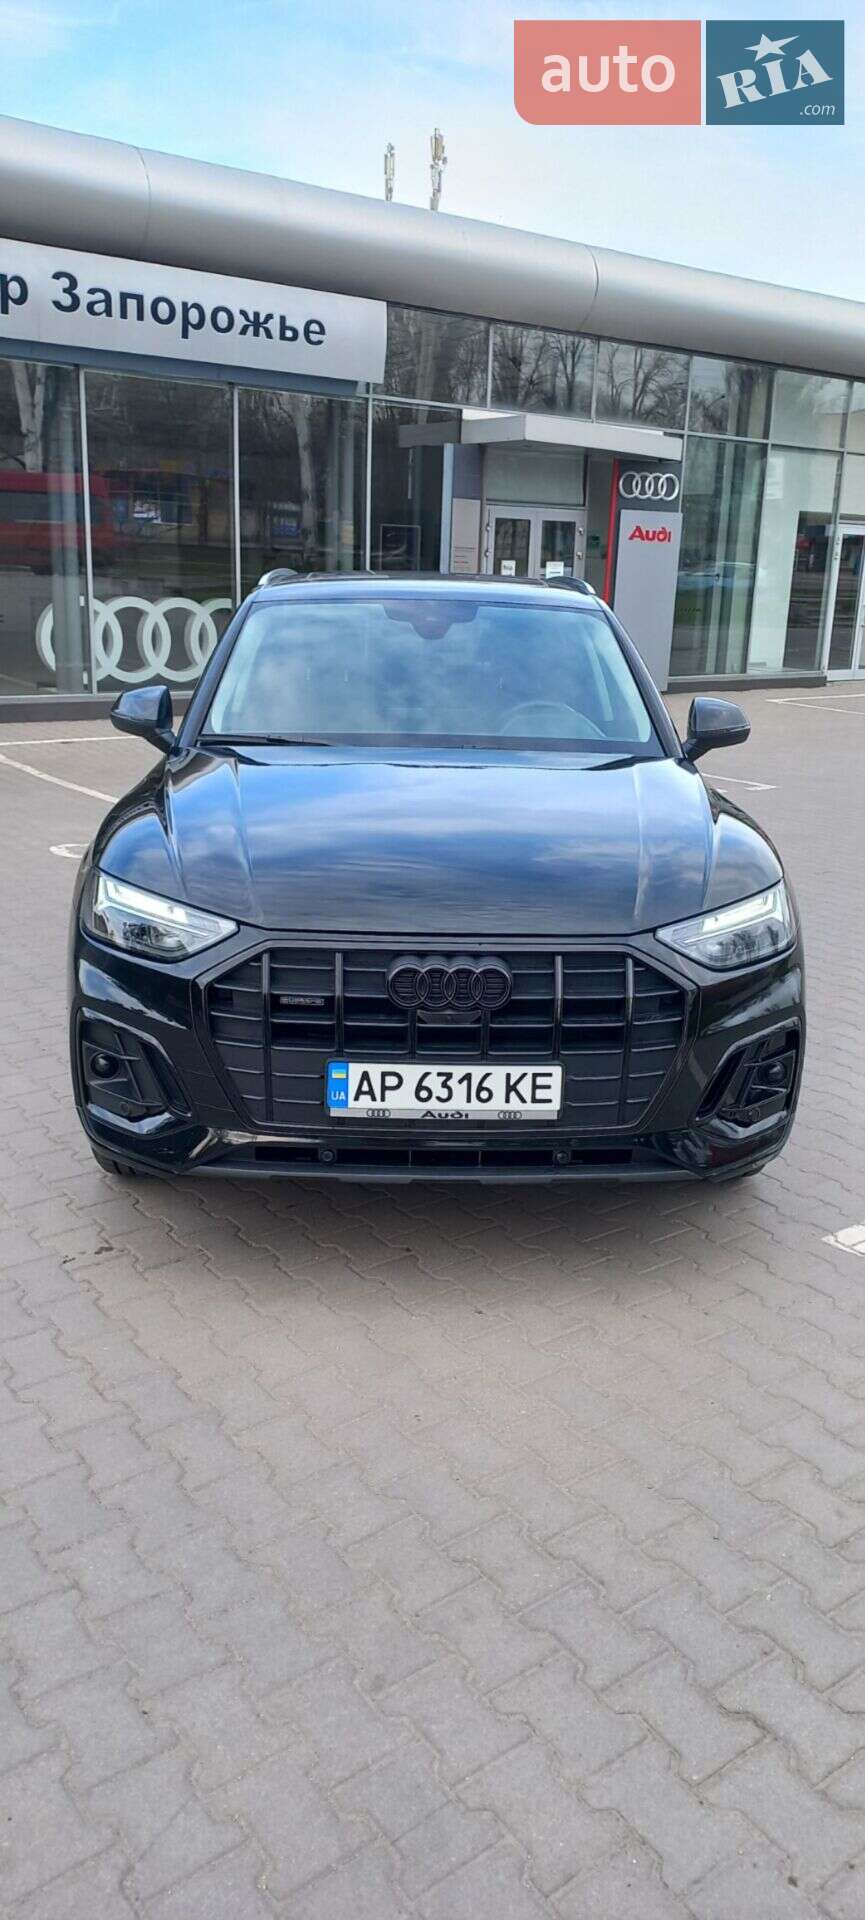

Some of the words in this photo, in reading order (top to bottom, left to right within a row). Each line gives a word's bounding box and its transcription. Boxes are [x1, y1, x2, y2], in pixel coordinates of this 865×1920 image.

[51, 270, 327, 346] Запорожье
[628, 525, 672, 543] Audi
[331, 1090, 346, 1102] UA
[353, 1070, 403, 1103] AP
[414, 1071, 494, 1104] 6316
[504, 1072, 553, 1104] KE
[421, 1110, 469, 1120] Audi
